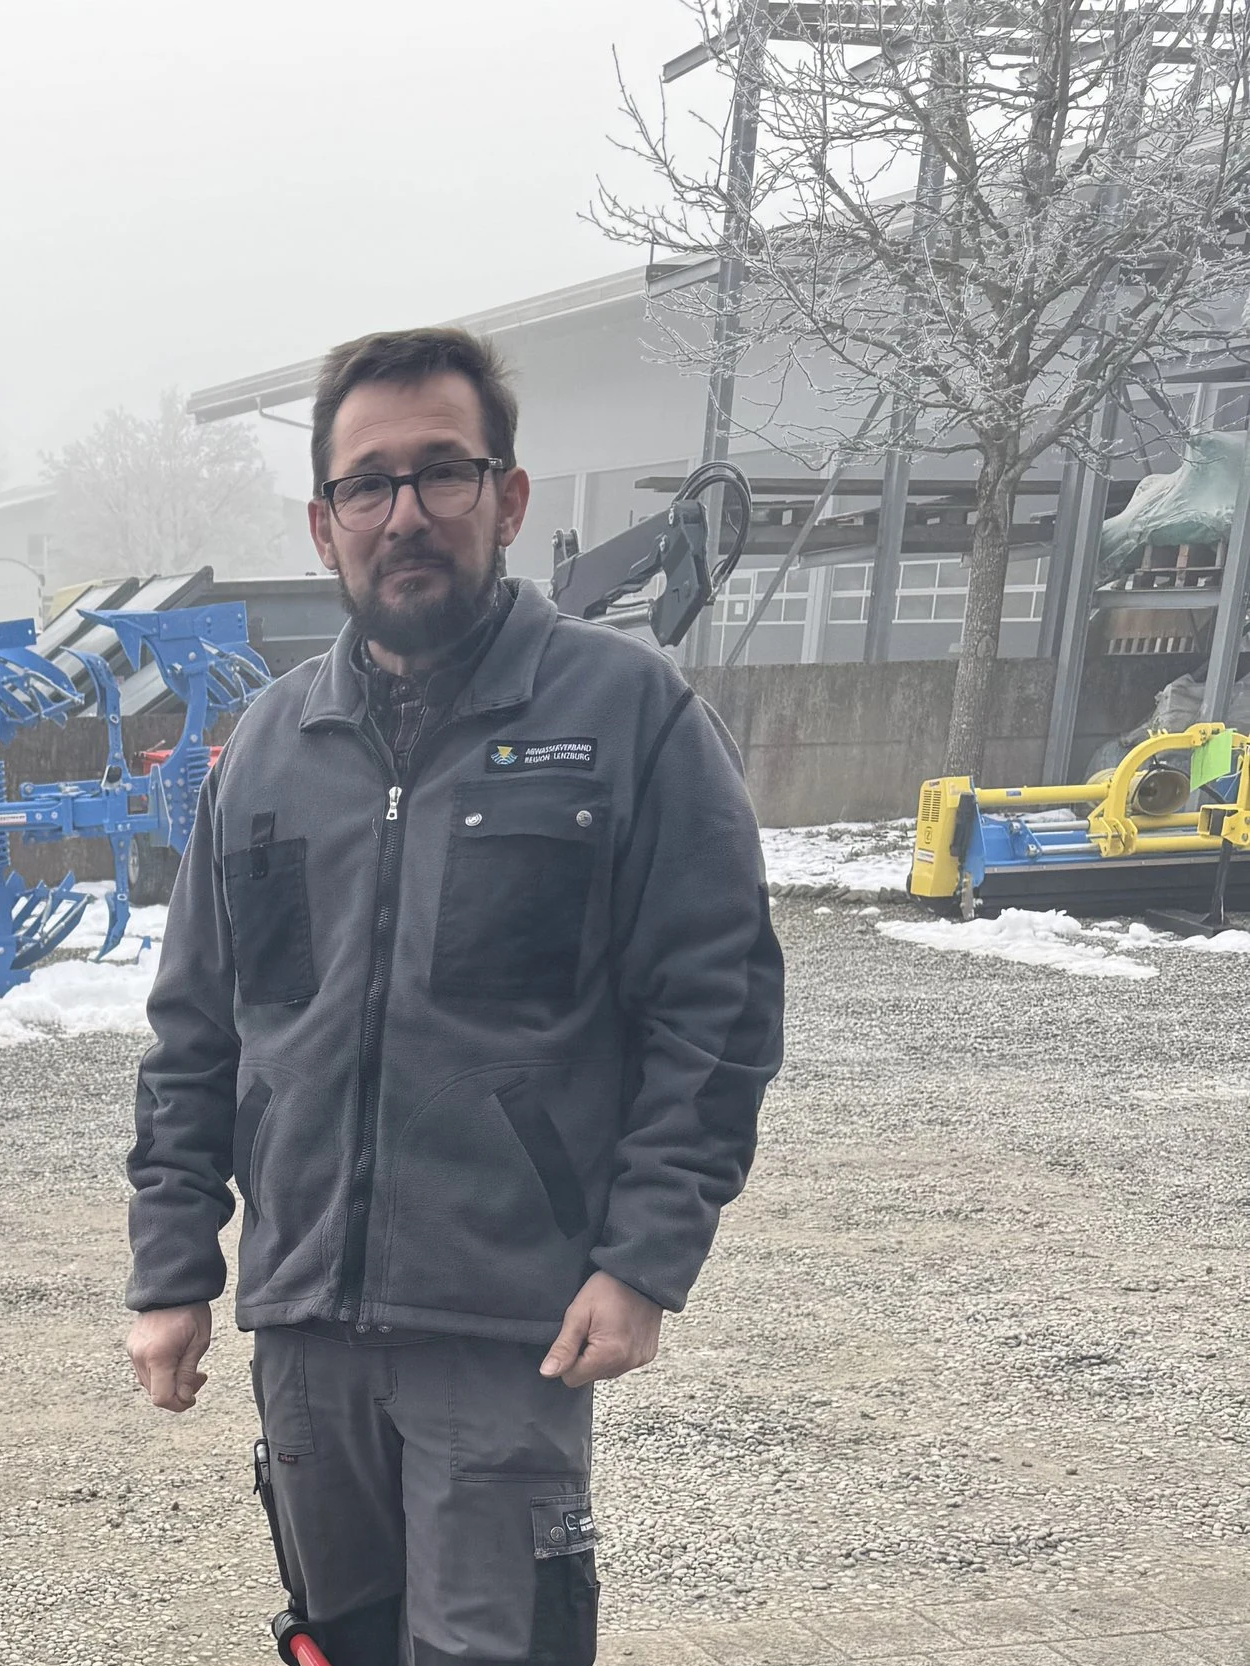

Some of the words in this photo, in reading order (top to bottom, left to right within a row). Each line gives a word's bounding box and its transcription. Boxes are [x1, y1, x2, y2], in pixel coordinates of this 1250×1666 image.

[525, 744, 591, 755] ABWASSERVERBAND
[524, 754, 550, 763] REGION
[553, 752, 589, 761] LENZBURG
